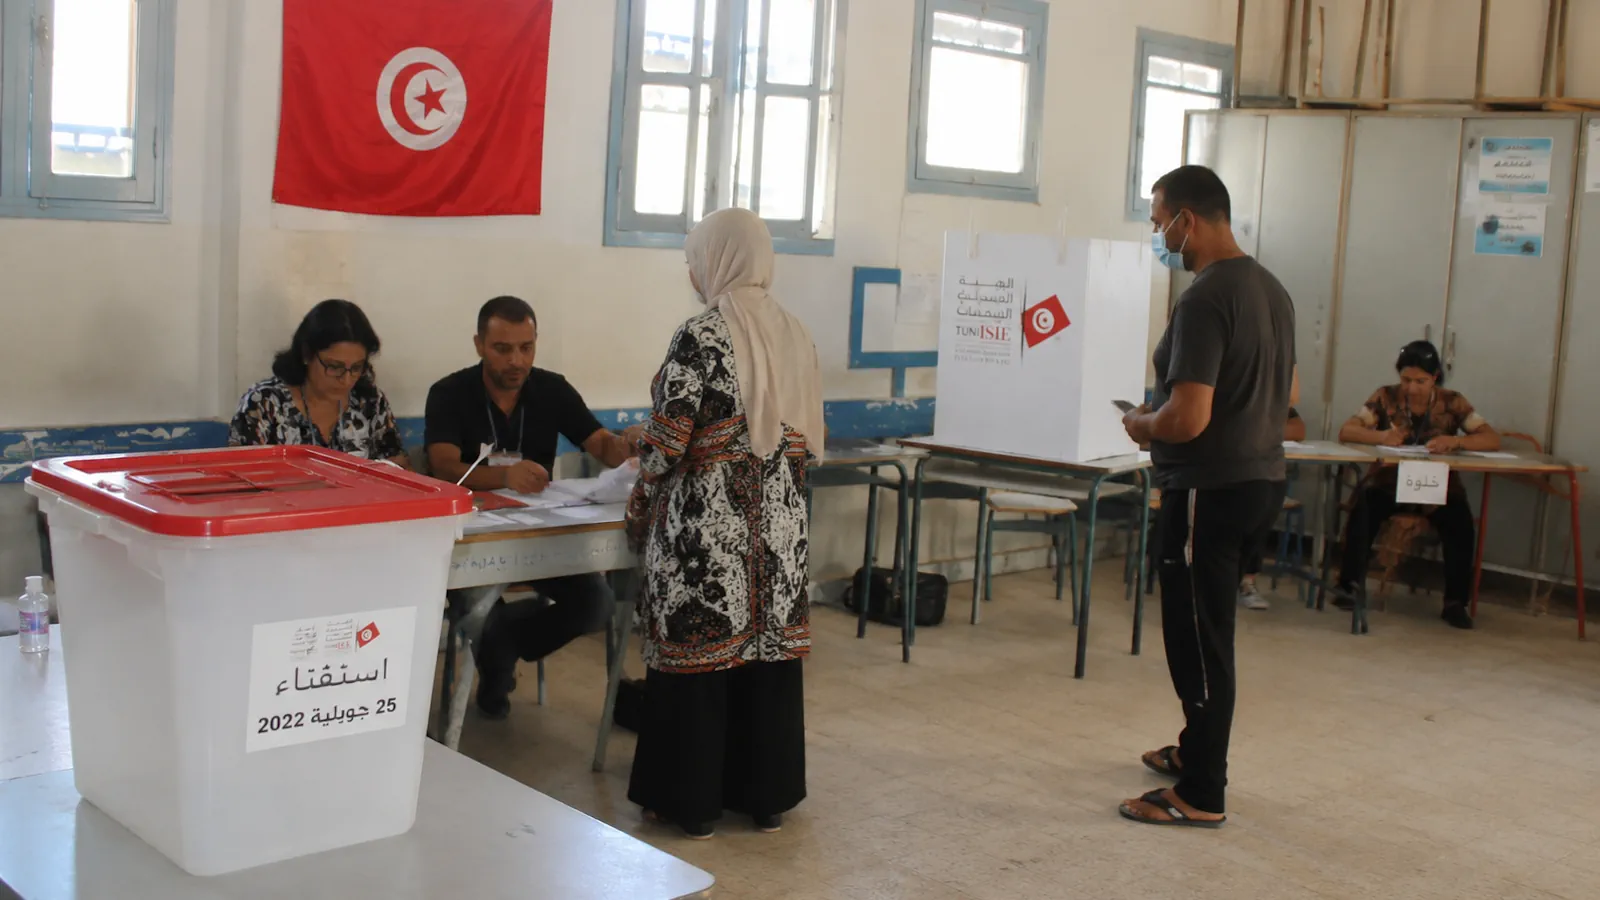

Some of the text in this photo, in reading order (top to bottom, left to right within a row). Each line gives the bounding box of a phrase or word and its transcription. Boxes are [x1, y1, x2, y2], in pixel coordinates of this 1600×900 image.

[1406, 474, 1439, 491] خلوة
[257, 697, 397, 734] 25 جويلية 2022
